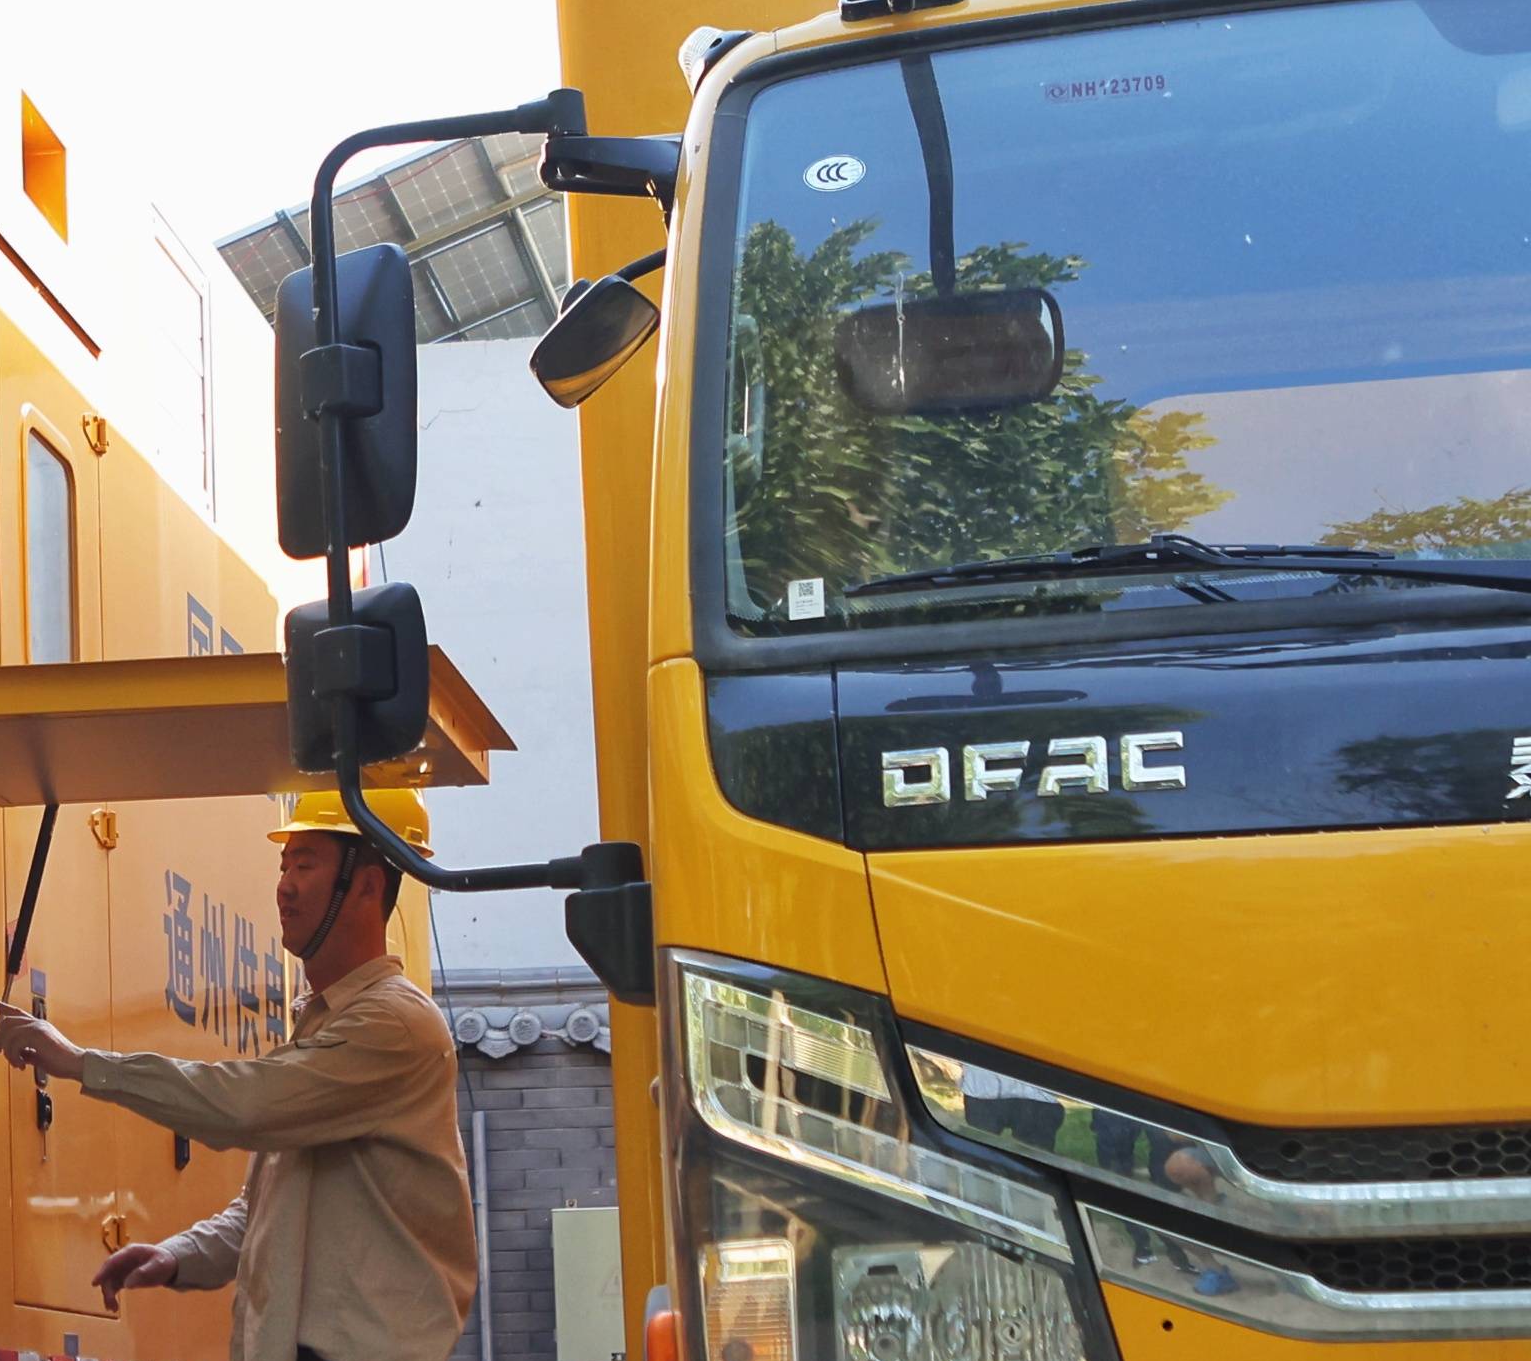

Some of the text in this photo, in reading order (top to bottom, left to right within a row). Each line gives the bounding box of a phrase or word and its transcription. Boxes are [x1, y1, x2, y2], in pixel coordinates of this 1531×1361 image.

[882, 731, 1186, 807] DFAC
[164, 869, 310, 1057] 通州供电
